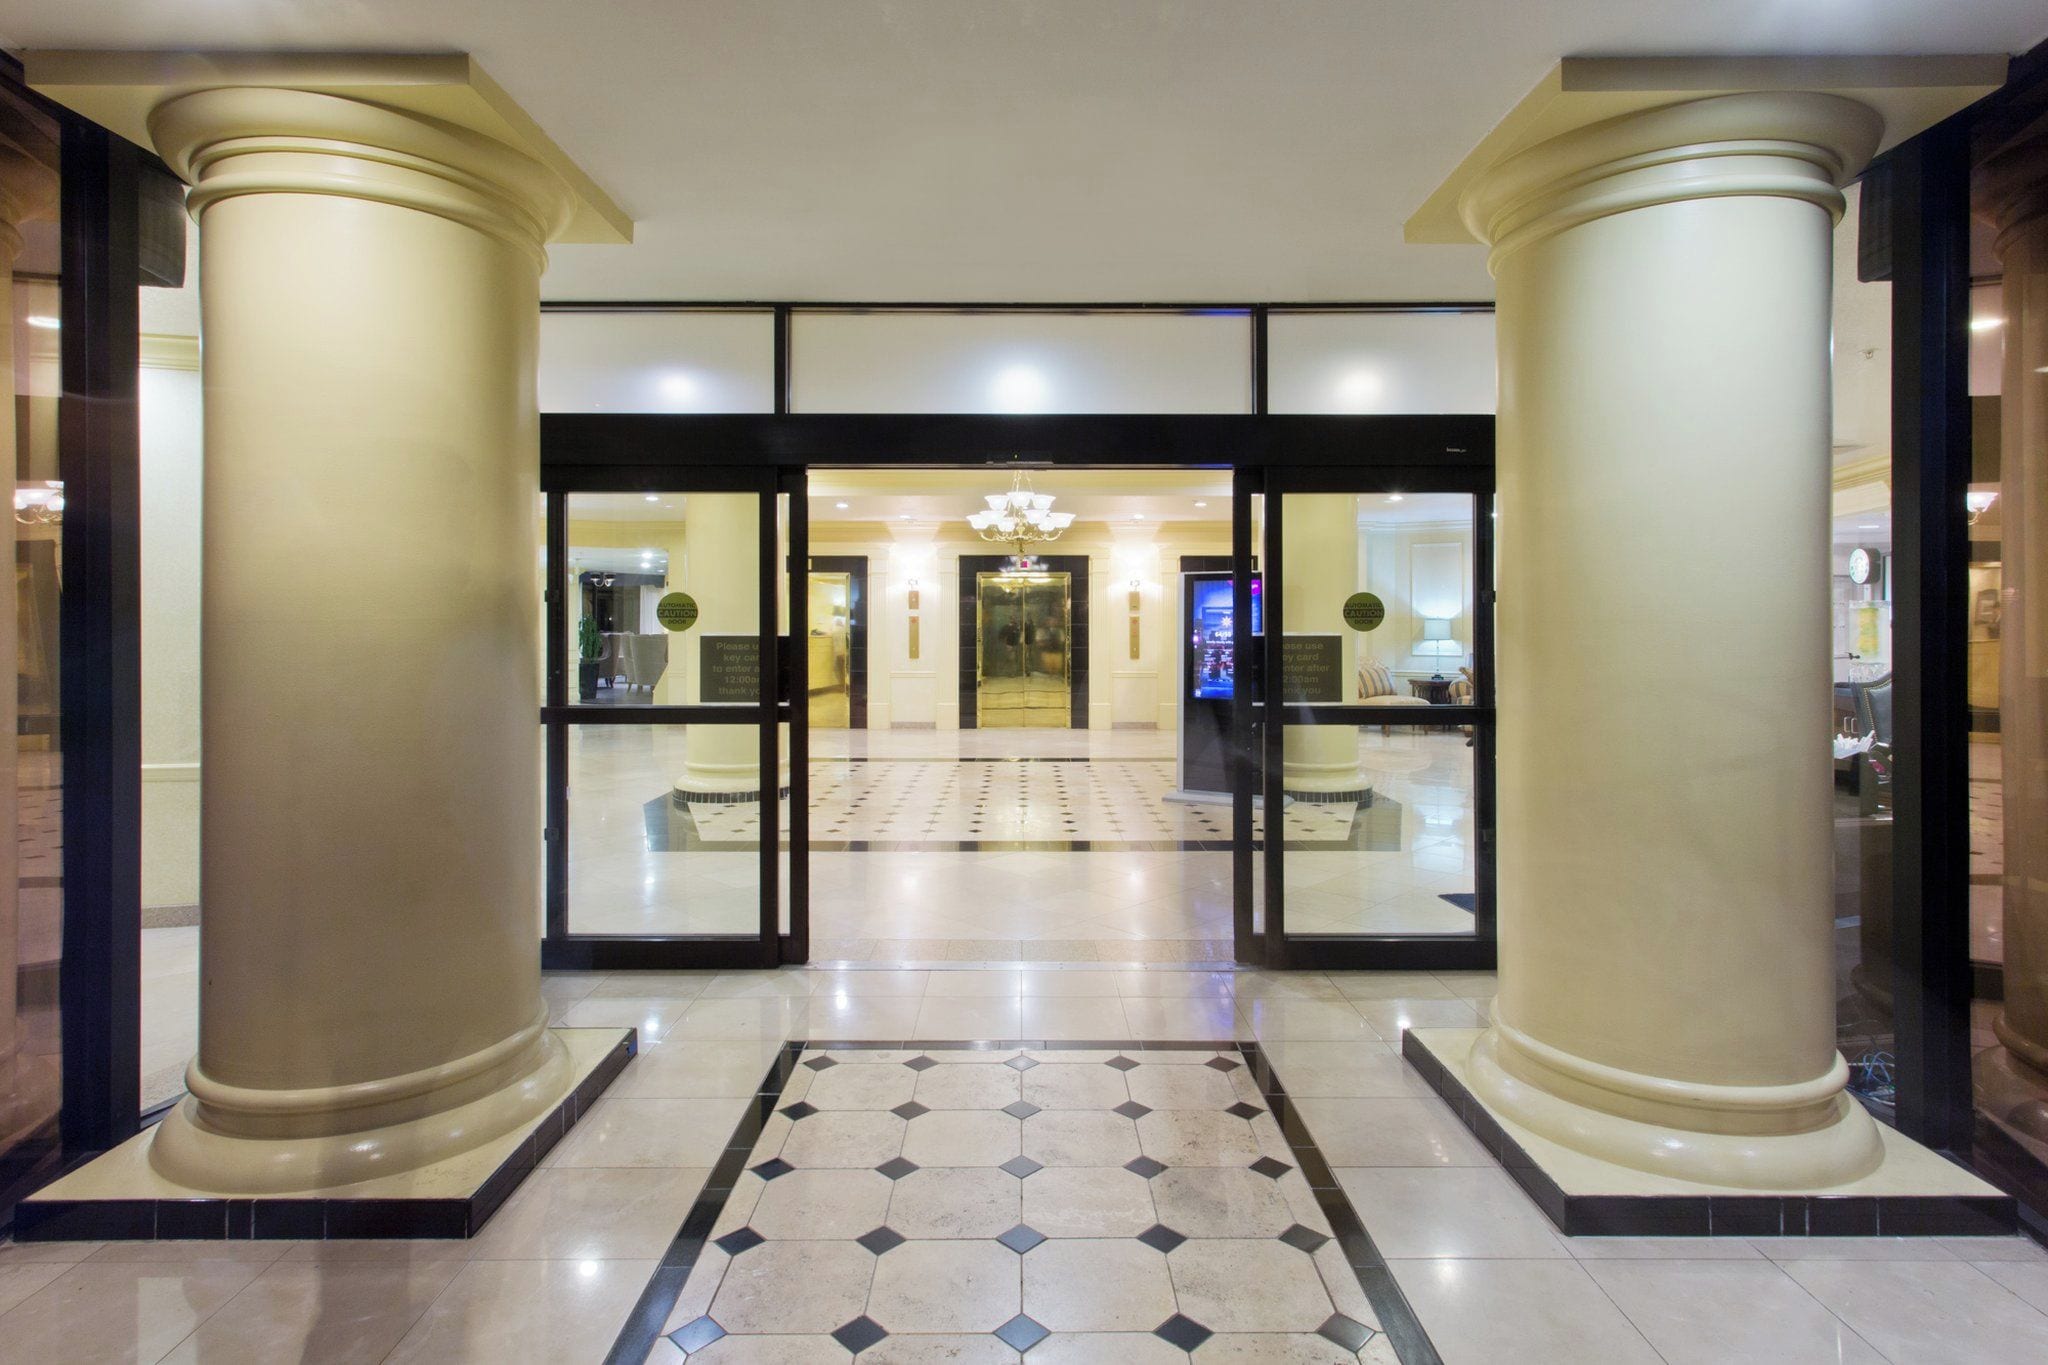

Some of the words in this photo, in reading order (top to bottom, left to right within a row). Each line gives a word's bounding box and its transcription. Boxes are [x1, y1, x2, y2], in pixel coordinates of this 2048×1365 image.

[716, 642, 750, 651] Please
[723, 653, 740, 662] key
[1283, 654, 1293, 662] ey
[1297, 652, 1319, 661] card
[713, 664, 723, 673] to
[726, 664, 751, 673] enter
[1306, 664, 1329, 672] after
[718, 686, 747, 696] thank
